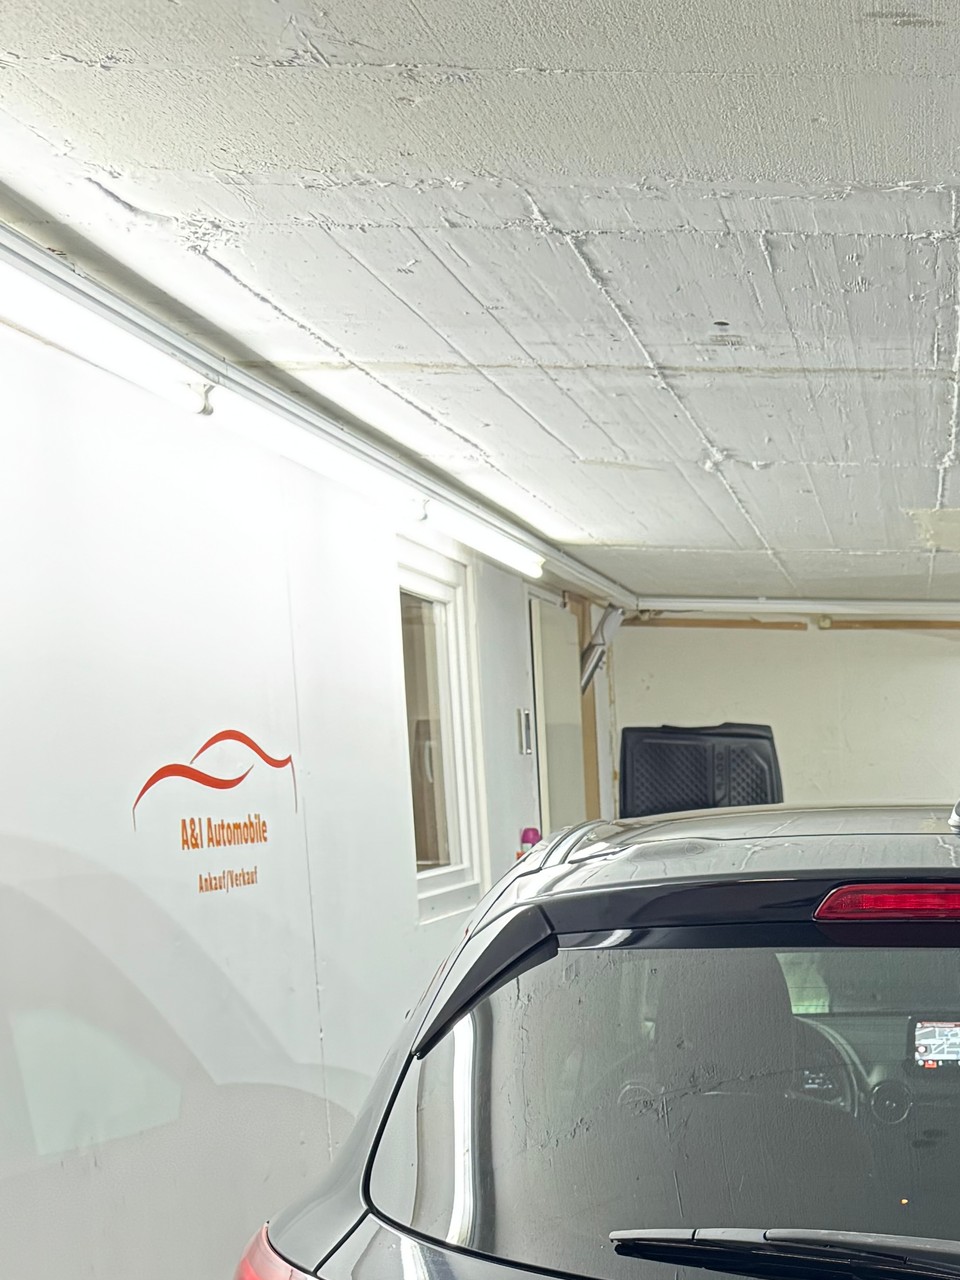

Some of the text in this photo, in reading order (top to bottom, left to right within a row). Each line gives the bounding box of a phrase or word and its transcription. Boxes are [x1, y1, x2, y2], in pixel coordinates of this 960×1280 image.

[180, 813, 268, 850] A&I Automobile
[198, 866, 258, 893] Ankauf/Verkauf
